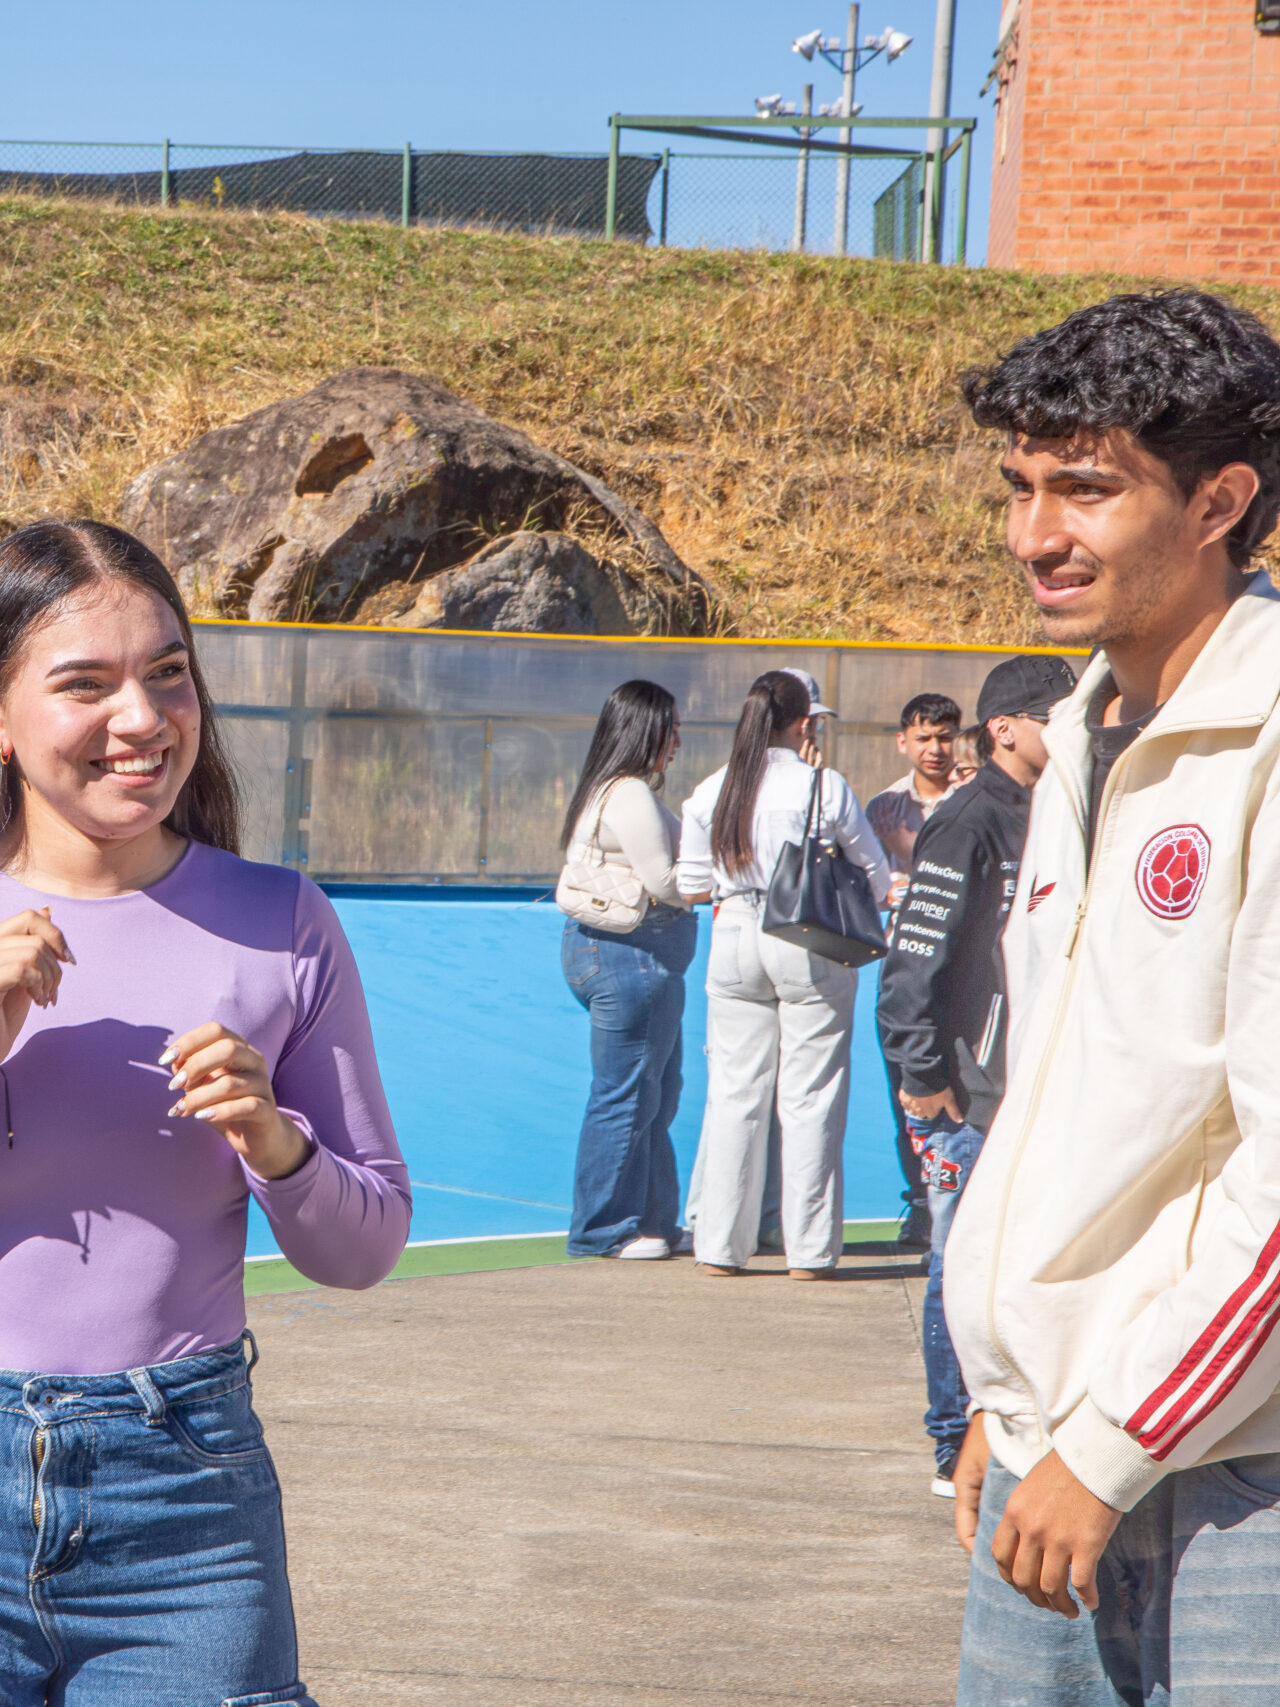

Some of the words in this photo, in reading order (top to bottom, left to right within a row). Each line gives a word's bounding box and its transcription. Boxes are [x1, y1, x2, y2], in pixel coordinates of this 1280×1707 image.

[924, 861, 964, 882] NexGen
[919, 884, 959, 900] crypto.com
[898, 937, 936, 957] BOSS
